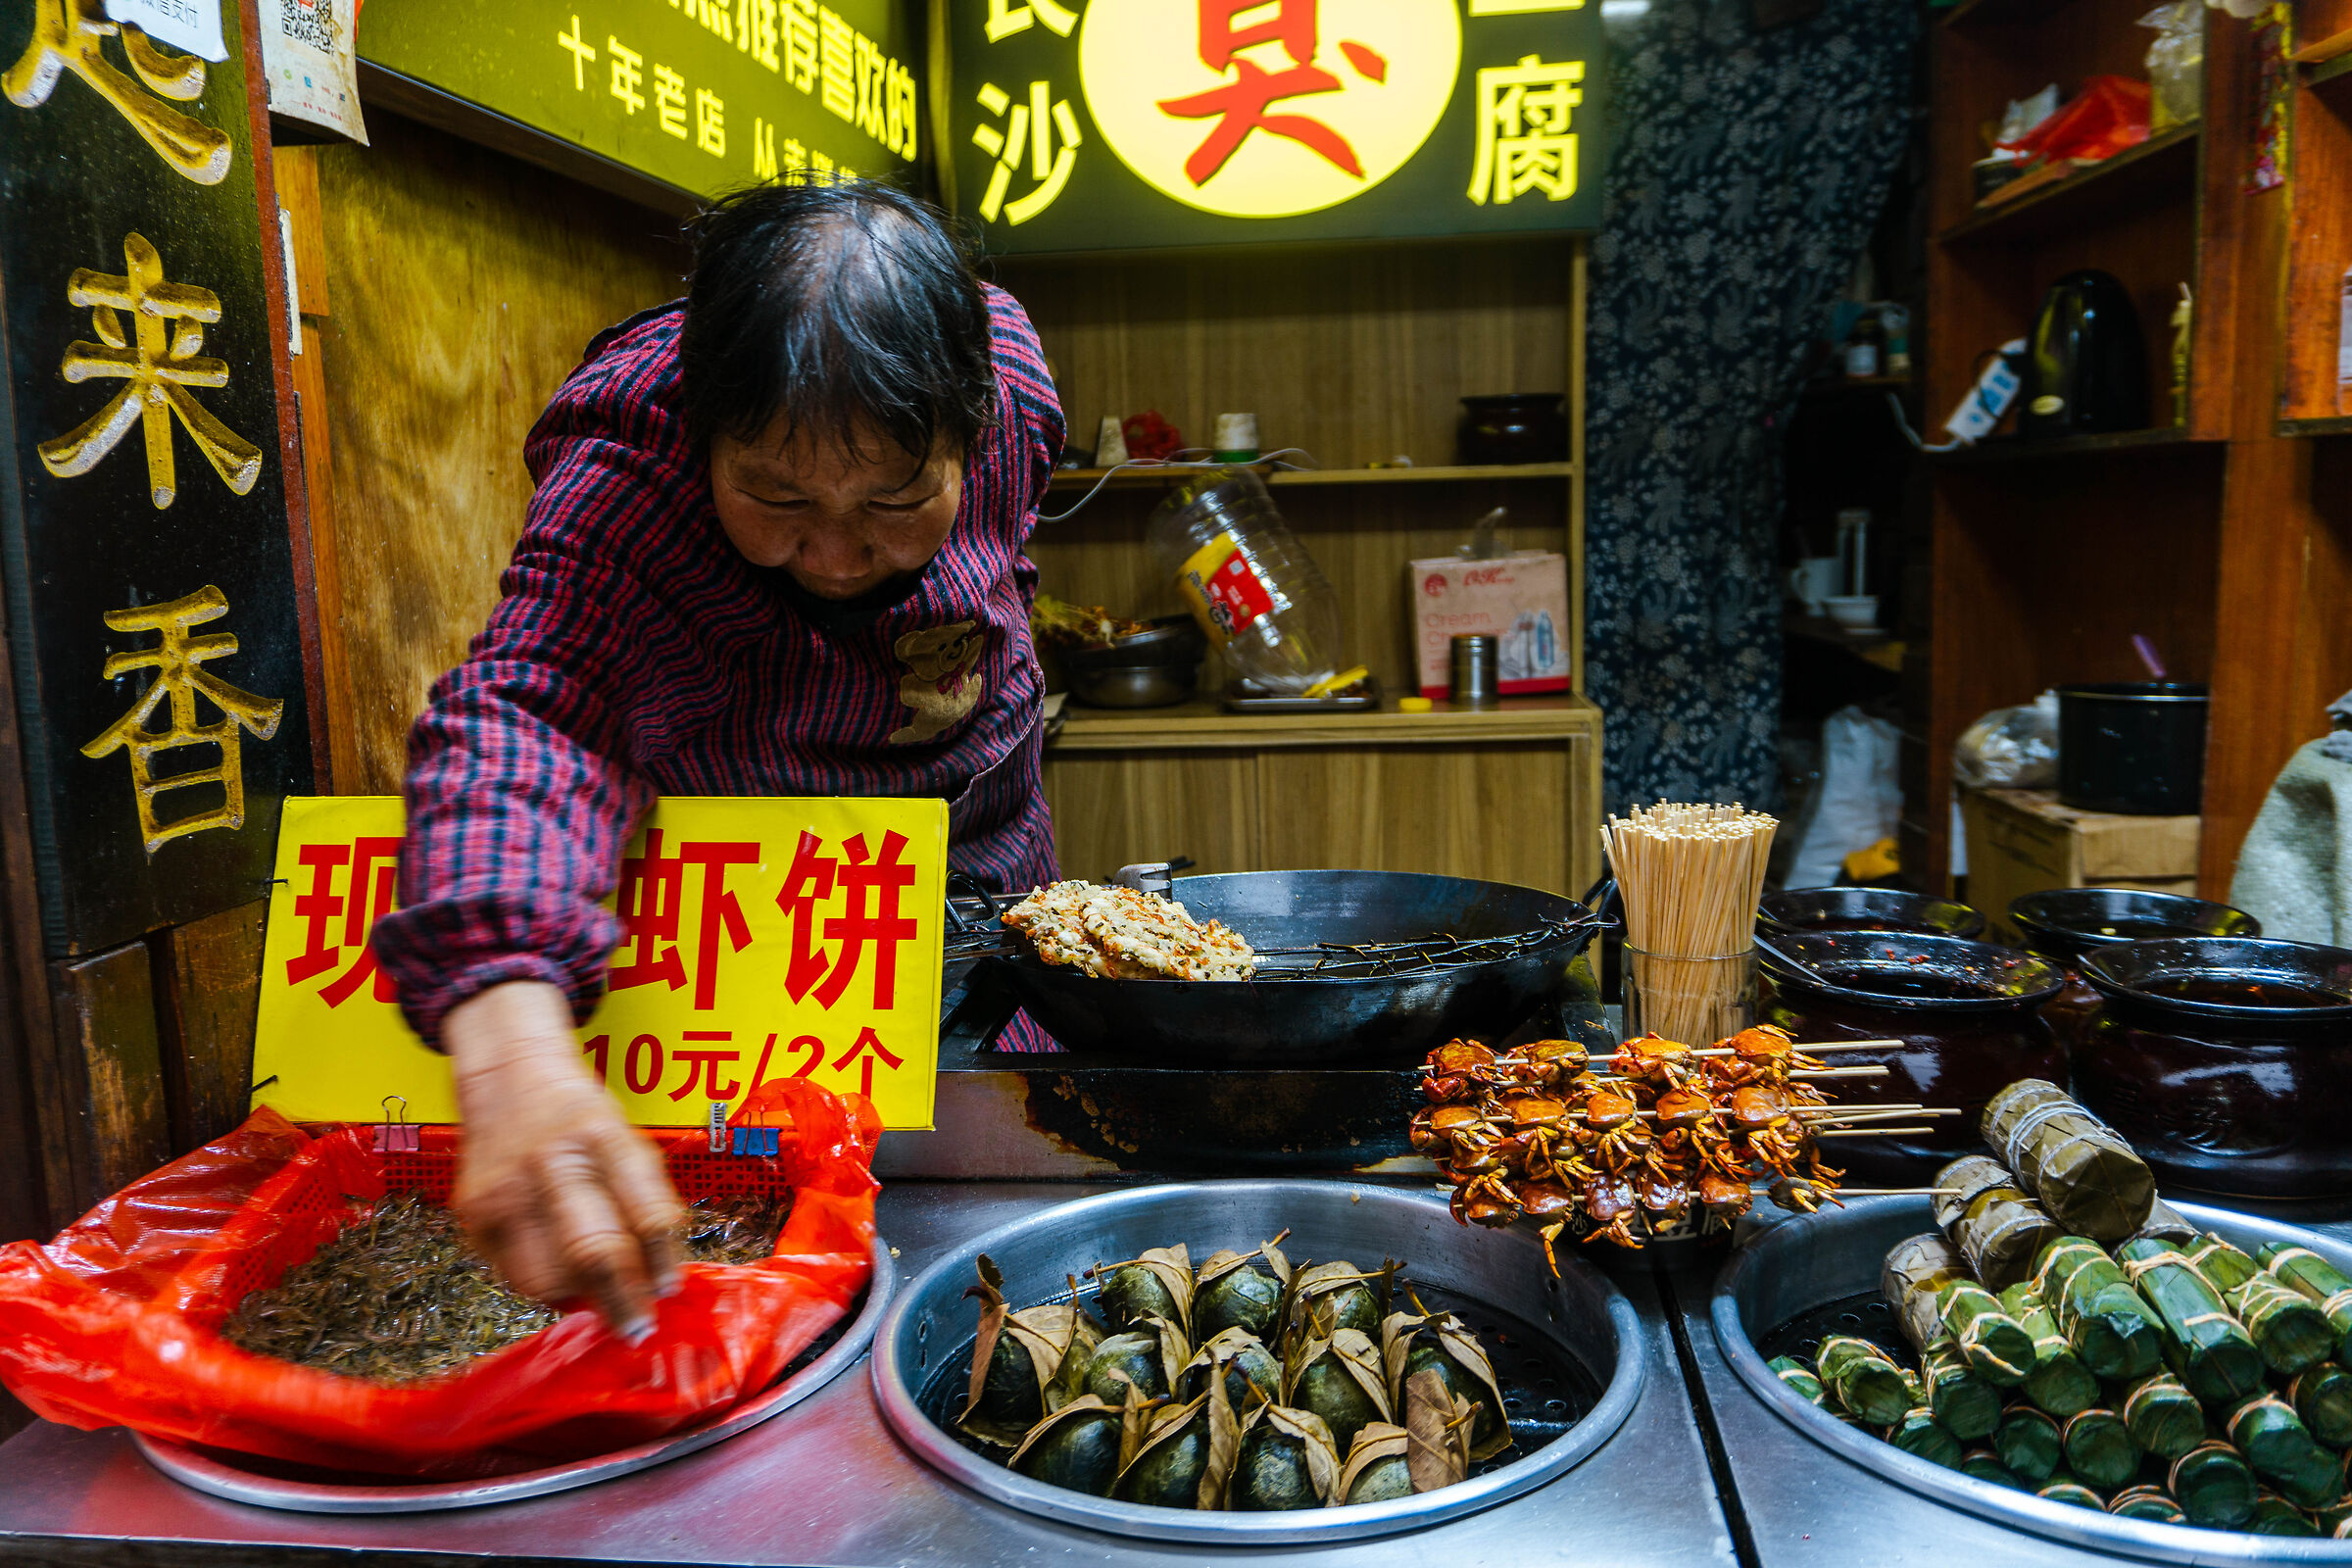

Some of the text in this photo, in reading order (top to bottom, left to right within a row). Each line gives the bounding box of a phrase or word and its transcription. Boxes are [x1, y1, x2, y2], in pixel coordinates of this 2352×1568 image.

[557, 14, 726, 159] 十年老店
[668, 0, 917, 163] 推荐喜欢的
[1157, 0, 1386, 187] 臭
[1467, 0, 1586, 206] 腐
[286, 828, 917, 1011] 现虾饼
[583, 1026, 905, 1102] 10元/2个
